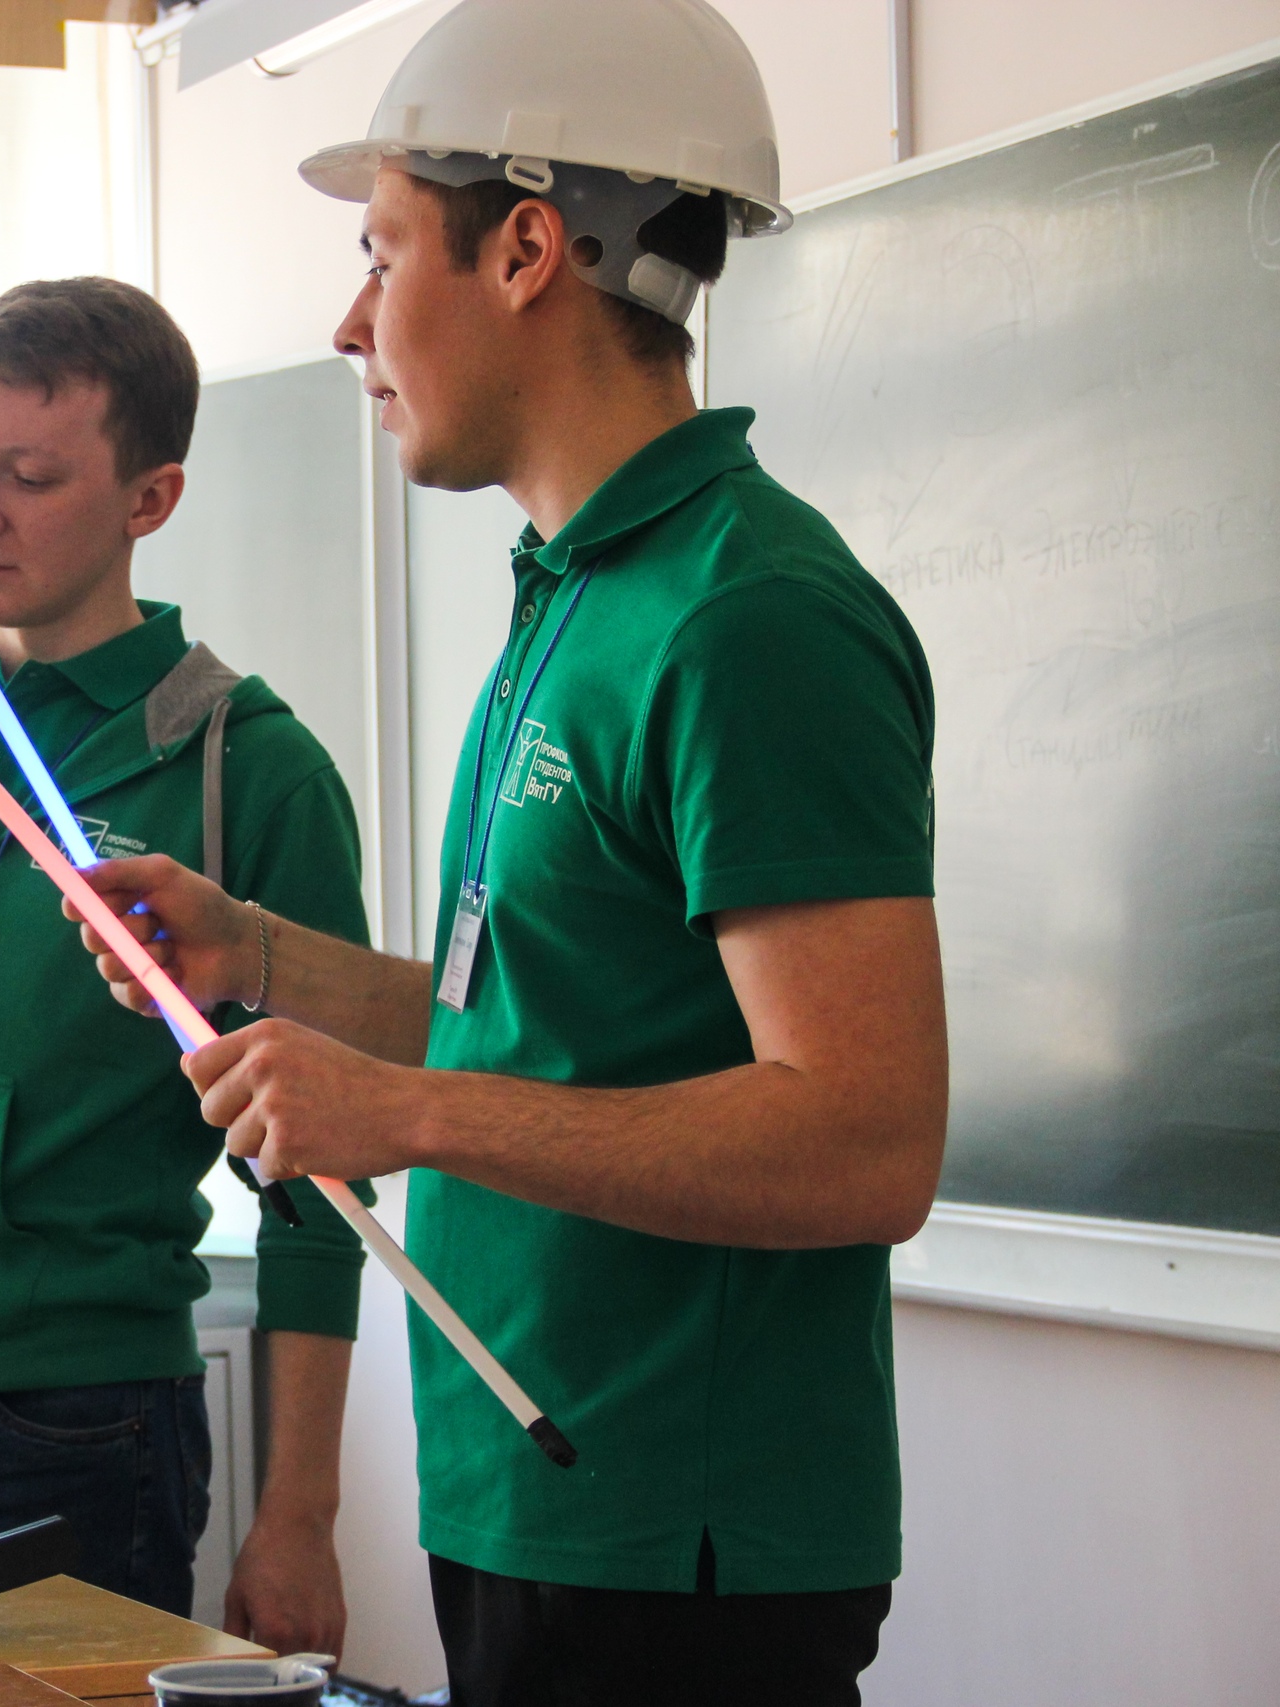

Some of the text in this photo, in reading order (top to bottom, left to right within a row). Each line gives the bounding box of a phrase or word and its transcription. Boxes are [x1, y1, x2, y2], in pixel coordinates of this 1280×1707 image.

[539, 741, 568, 764] ПРОФКОМ
[534, 758, 572, 783] СТУДЕНТОВ
[527, 776, 563, 804] ВятГУ
[105, 834, 147, 851] ПРОФКОМ
